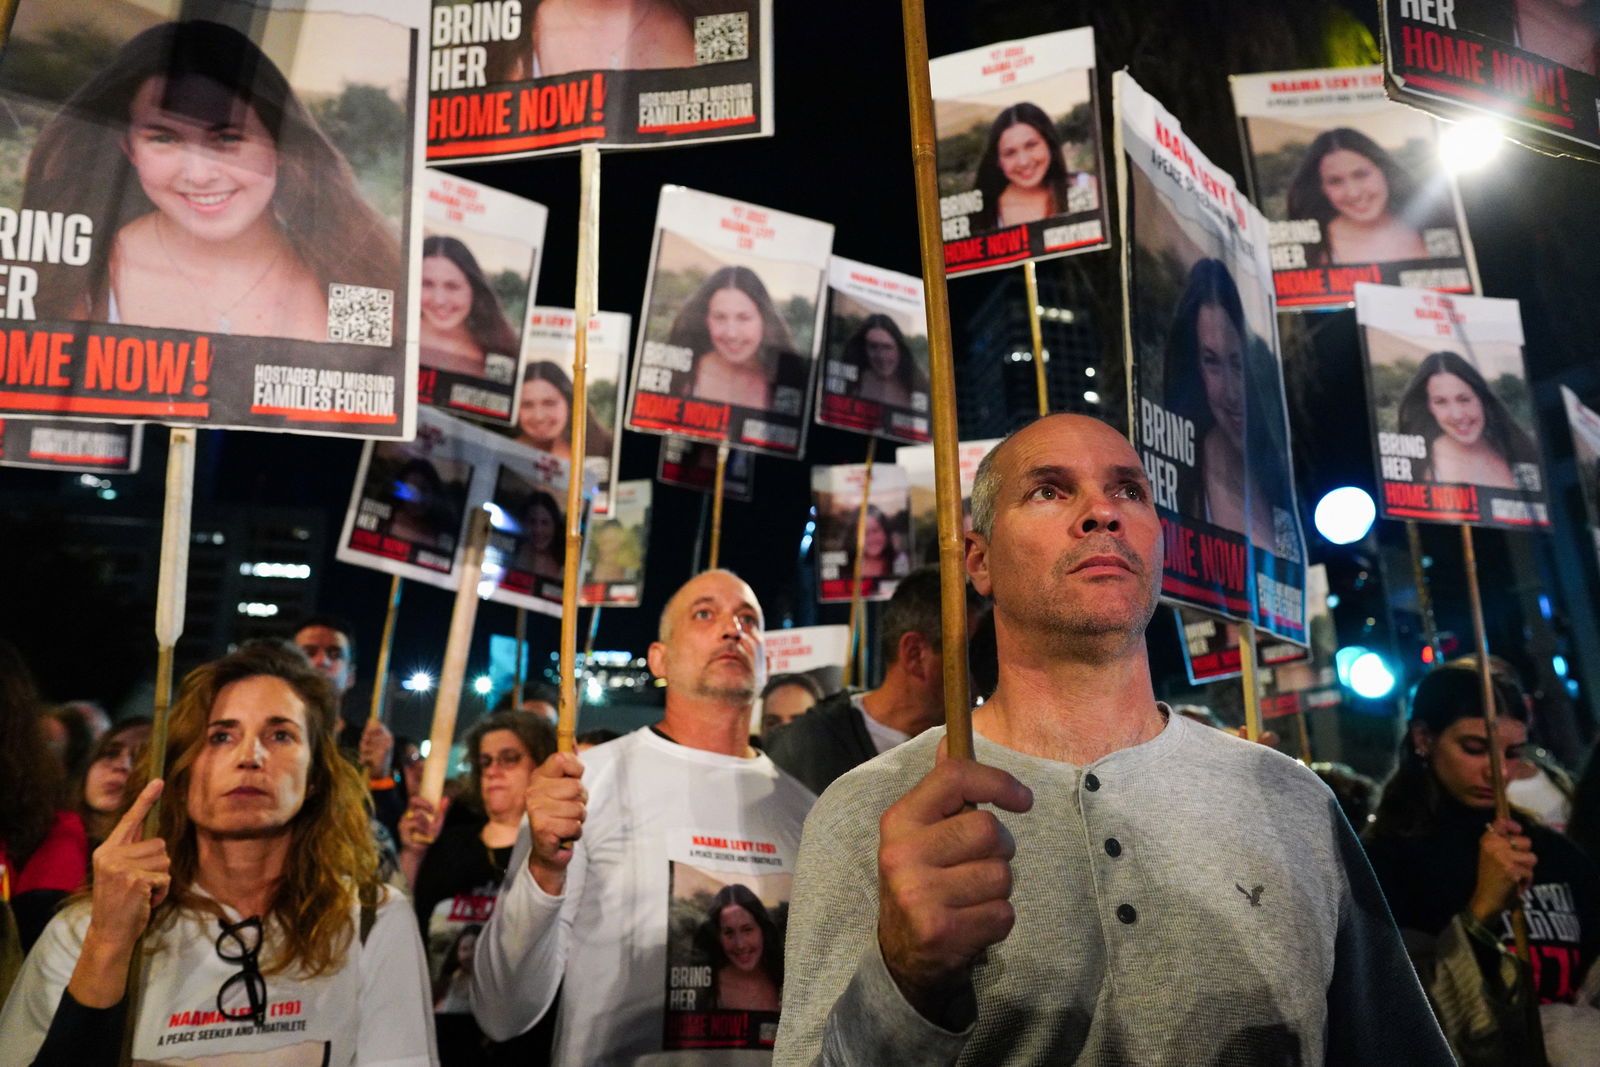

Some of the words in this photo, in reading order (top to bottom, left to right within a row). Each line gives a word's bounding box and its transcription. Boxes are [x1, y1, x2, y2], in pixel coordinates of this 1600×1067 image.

[432, 0, 522, 47] BRING
[430, 46, 487, 91] HER
[1402, 26, 1485, 85] HOME
[1492, 50, 1571, 113] NOW!
[428, 91, 513, 140] HOME
[518, 73, 604, 133] NOW!
[639, 102, 701, 127] FAMILIES
[703, 97, 753, 122] FORUM
[0, 207, 94, 266] RING
[943, 237, 985, 265] HOME
[986, 224, 1029, 257] NOW!
[84, 335, 210, 397] NOW!
[255, 364, 317, 387] HOSTAGES
[317, 369, 343, 390] AND
[343, 371, 395, 394] MISSING
[253, 382, 332, 412] FAMILIES
[334, 389, 395, 416] FORUM
[682, 401, 731, 432] NOW!
[1141, 397, 1195, 467] BRING
[1378, 431, 1427, 459] BRING
[1143, 451, 1179, 513] HER
[1381, 456, 1414, 482] HER
[1384, 482, 1430, 509] HOME
[1430, 484, 1479, 512] NOW!
[1161, 516, 1198, 578] OME
[1199, 533, 1246, 592] NOW
[692, 836, 728, 849] NAAMA
[730, 840, 753, 852] LEVY
[670, 965, 712, 988] BRING
[168, 1009, 226, 1028] NAAMA
[270, 1000, 301, 1018] (19)
[669, 988, 696, 1011] HER
[157, 1035, 163, 1046] A
[166, 1031, 194, 1046] PEACE
[198, 1026, 233, 1042] SEEKER
[235, 1026, 254, 1037] AND
[255, 1020, 306, 1035] TRIATHLETE
[709, 1012, 750, 1038] NOW!
